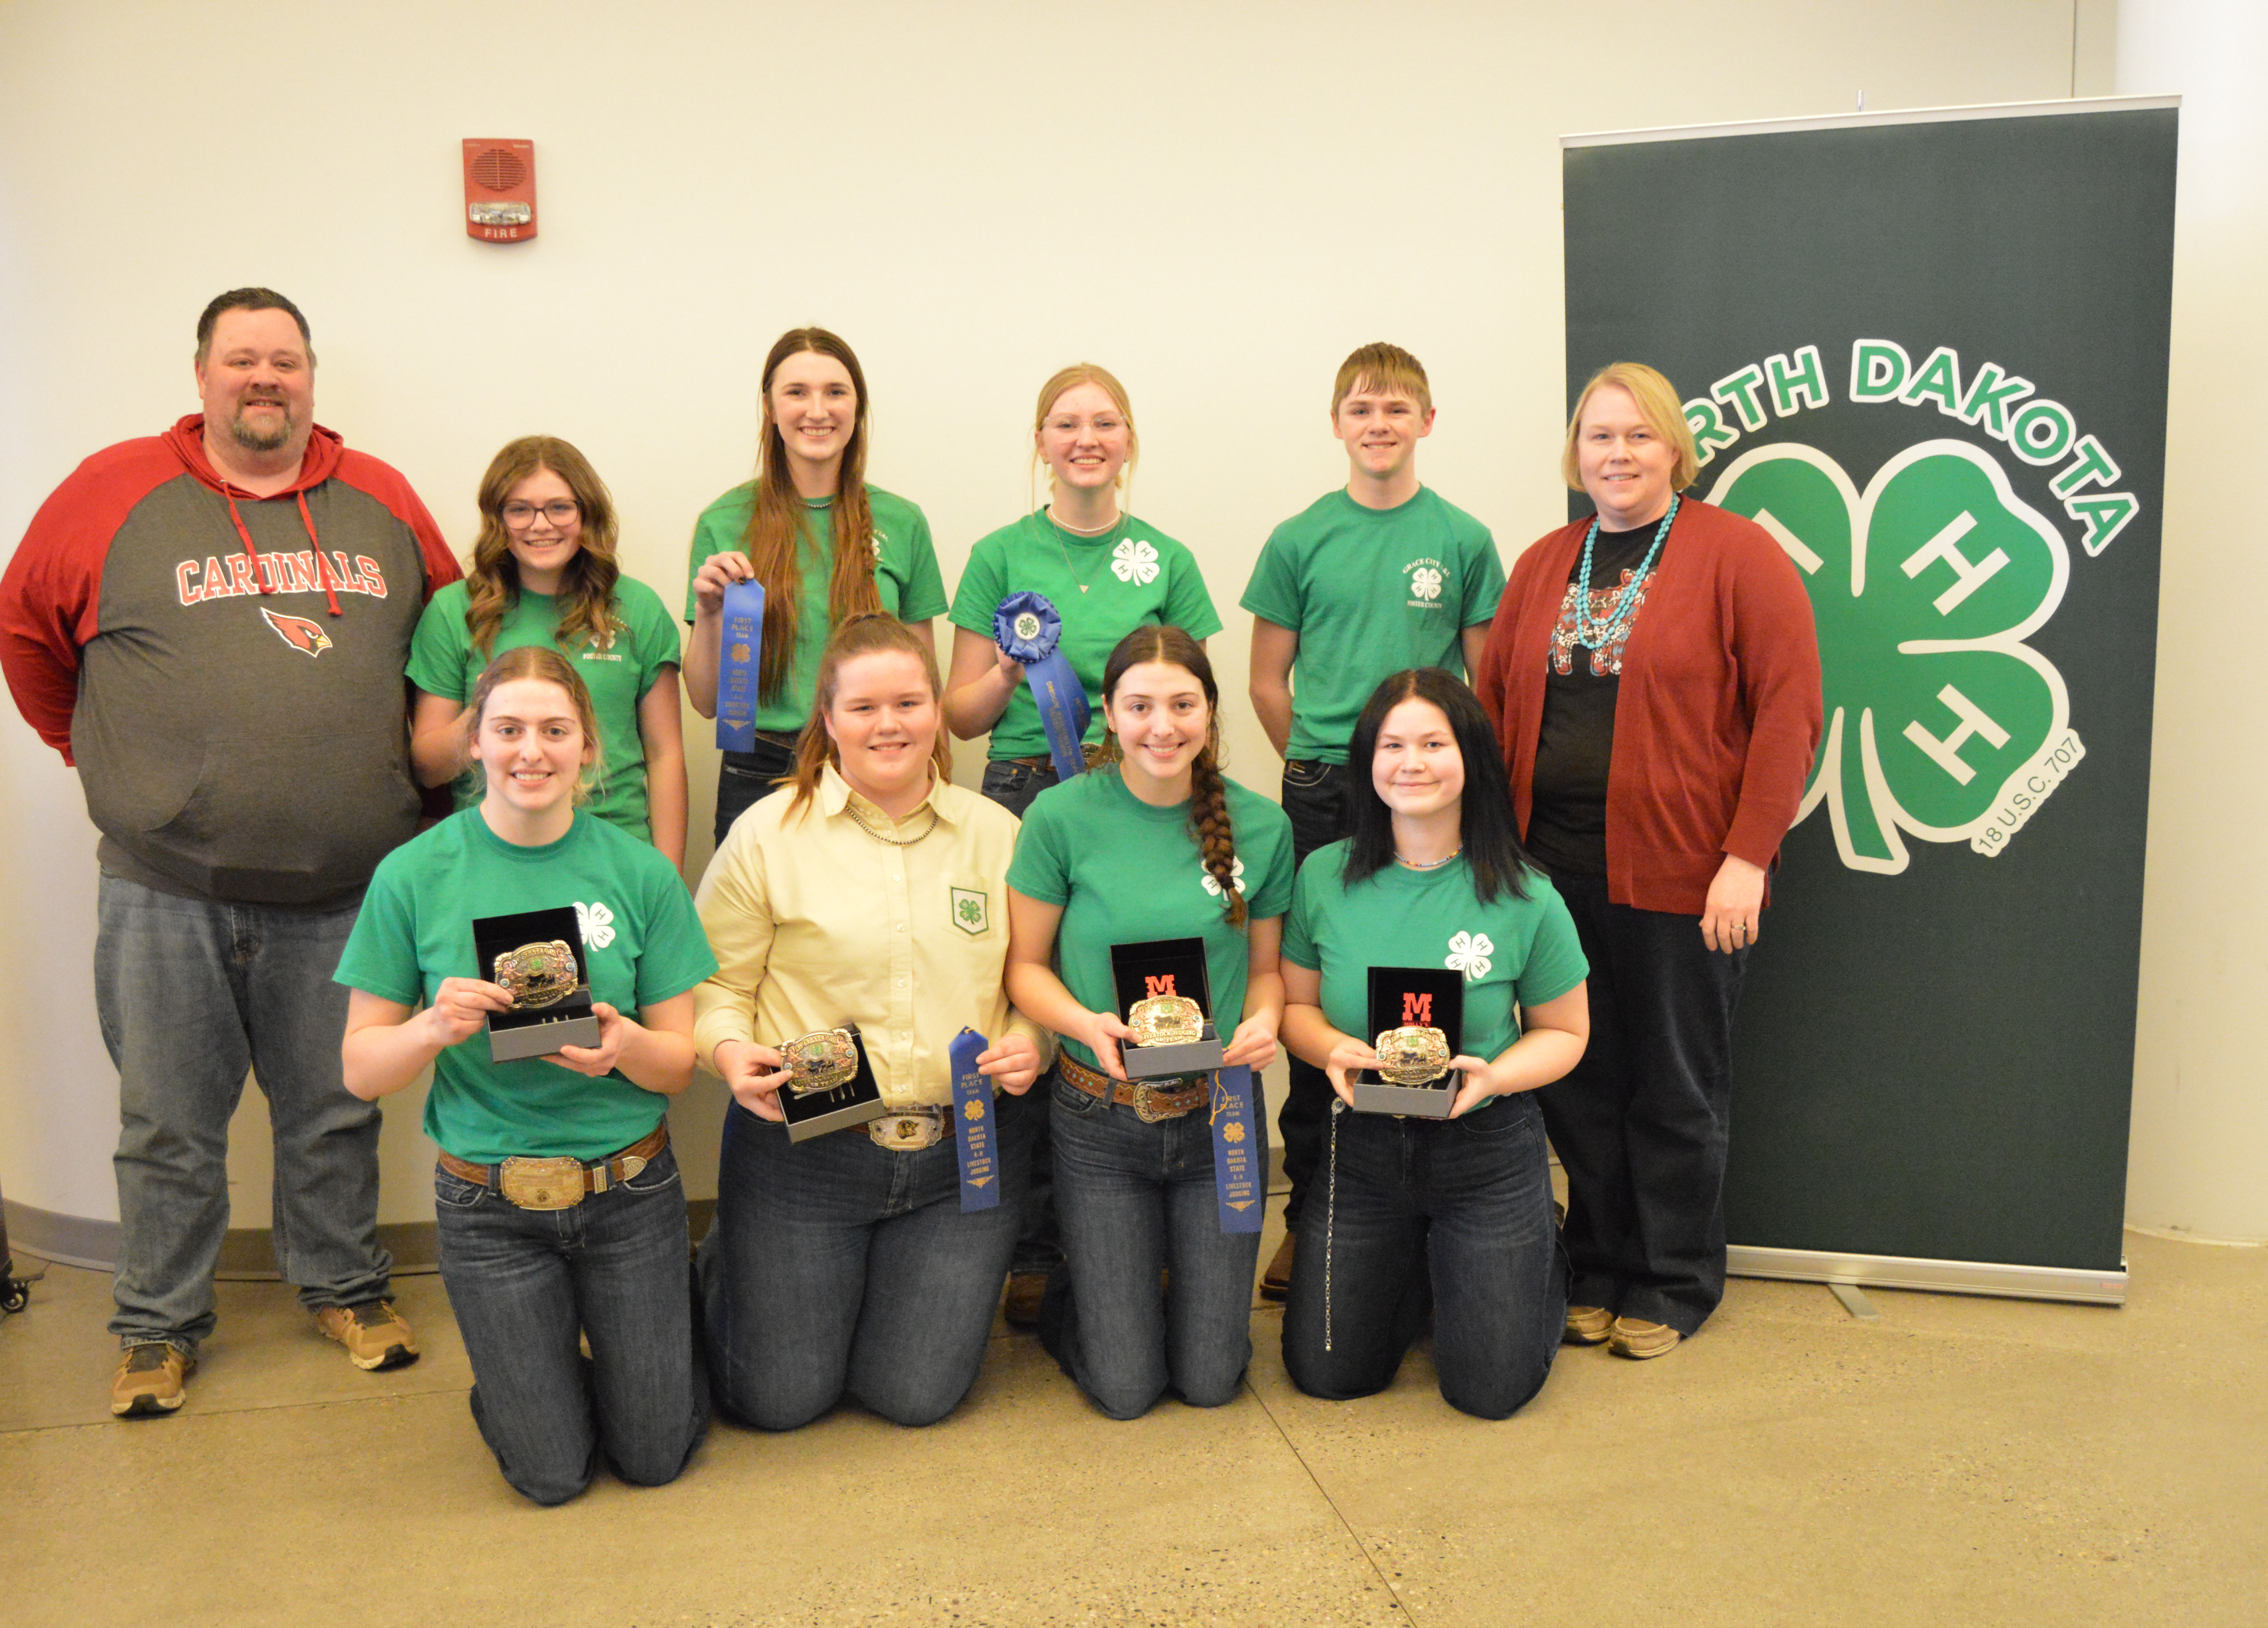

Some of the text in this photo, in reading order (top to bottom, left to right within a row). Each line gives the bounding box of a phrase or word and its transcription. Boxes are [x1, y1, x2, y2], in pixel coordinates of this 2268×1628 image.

[485, 228, 517, 238] FIRE
[1682, 339, 2140, 558] RTH DAKOTA
[1403, 558, 1424, 573] GRACE
[1425, 557, 1440, 567] CITY
[176, 551, 387, 606] CARDINALS
[731, 624, 753, 632] PLACE
[1979, 736, 2077, 849] 18 U.S.C. 707
[521, 948, 544, 959] STATE
[1145, 975, 1177, 999] M
[1402, 992, 1432, 1022] M
[803, 1035, 825, 1046] STATE
[963, 1072, 979, 1081] FIRST
[961, 1079, 983, 1088] PLACE
[969, 1125, 984, 1134] NORTH
[968, 1133, 986, 1142] DAKOTA
[967, 1157, 991, 1167] LIVESTOCK
[970, 1166, 989, 1175] JUDGING
